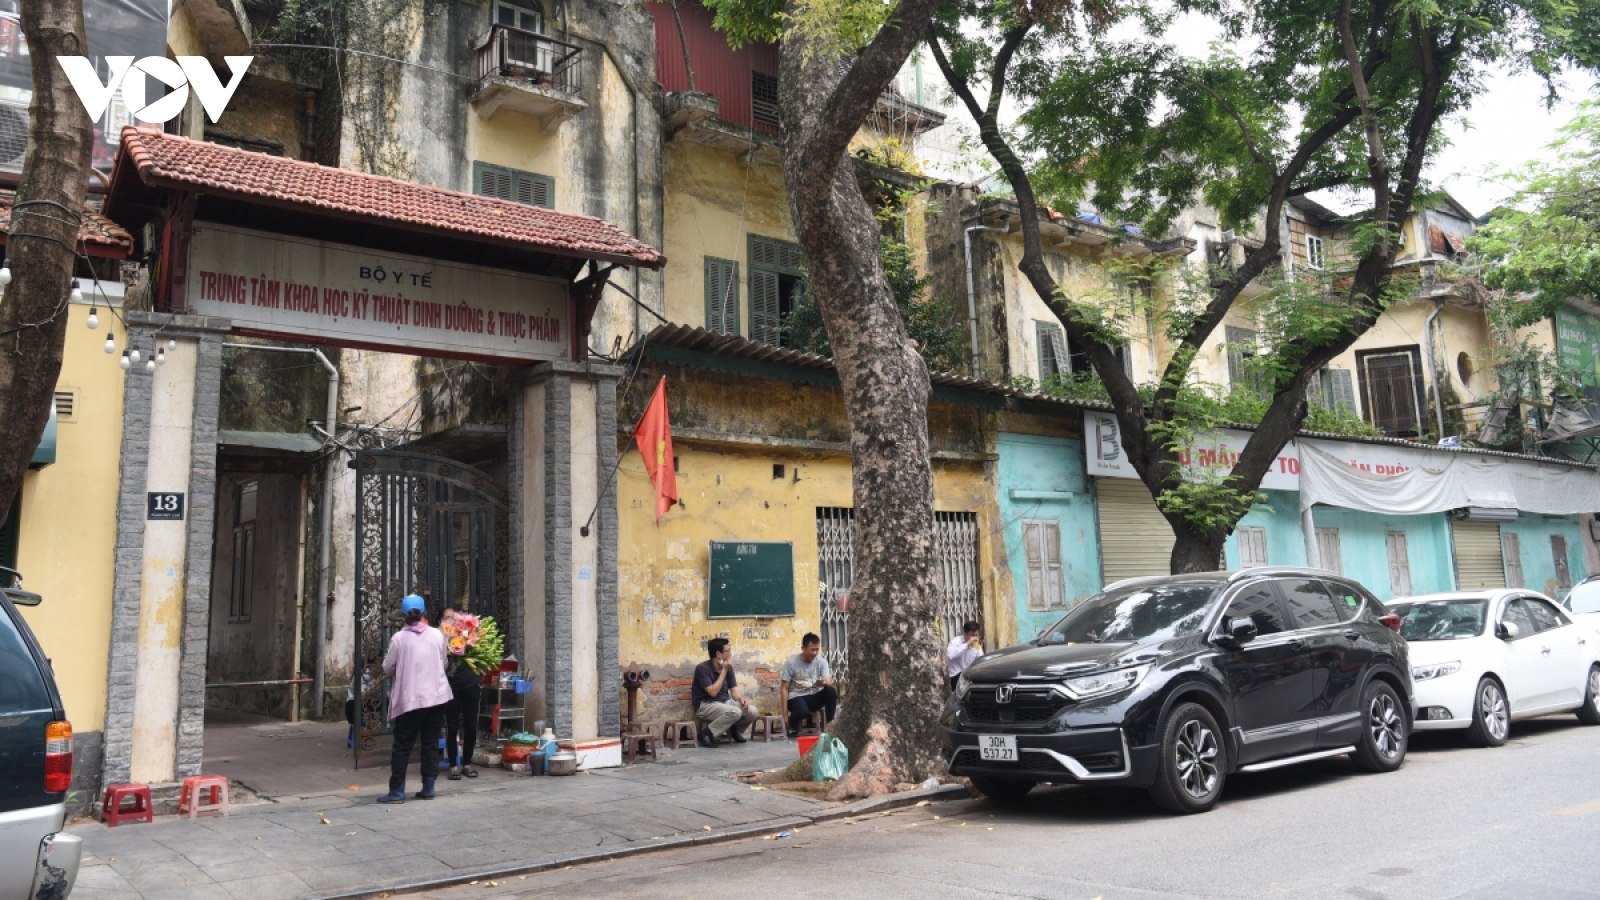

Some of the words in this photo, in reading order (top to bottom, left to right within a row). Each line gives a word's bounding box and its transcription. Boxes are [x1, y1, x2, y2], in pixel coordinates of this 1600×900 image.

[359, 266, 387, 284] BỘ
[392, 271, 404, 284] Y
[409, 271, 433, 288] TẾ
[199, 270, 247, 304] TRUNG
[250, 273, 281, 309] TÂM
[284, 282, 320, 314] KHOA
[323, 287, 349, 323] HỌC
[352, 290, 369, 320] KỸ
[372, 293, 411, 331] THUẬT
[413, 300, 442, 328] DINH
[445, 300, 484, 334] DƯỠNG
[487, 310, 496, 335] &
[499, 311, 526, 344] THỰC
[529, 307, 561, 343] PHẨM
[154, 495, 178, 511] 13
[988, 736, 1006, 747] 30H
[983, 748, 1013, 760] 537.27
